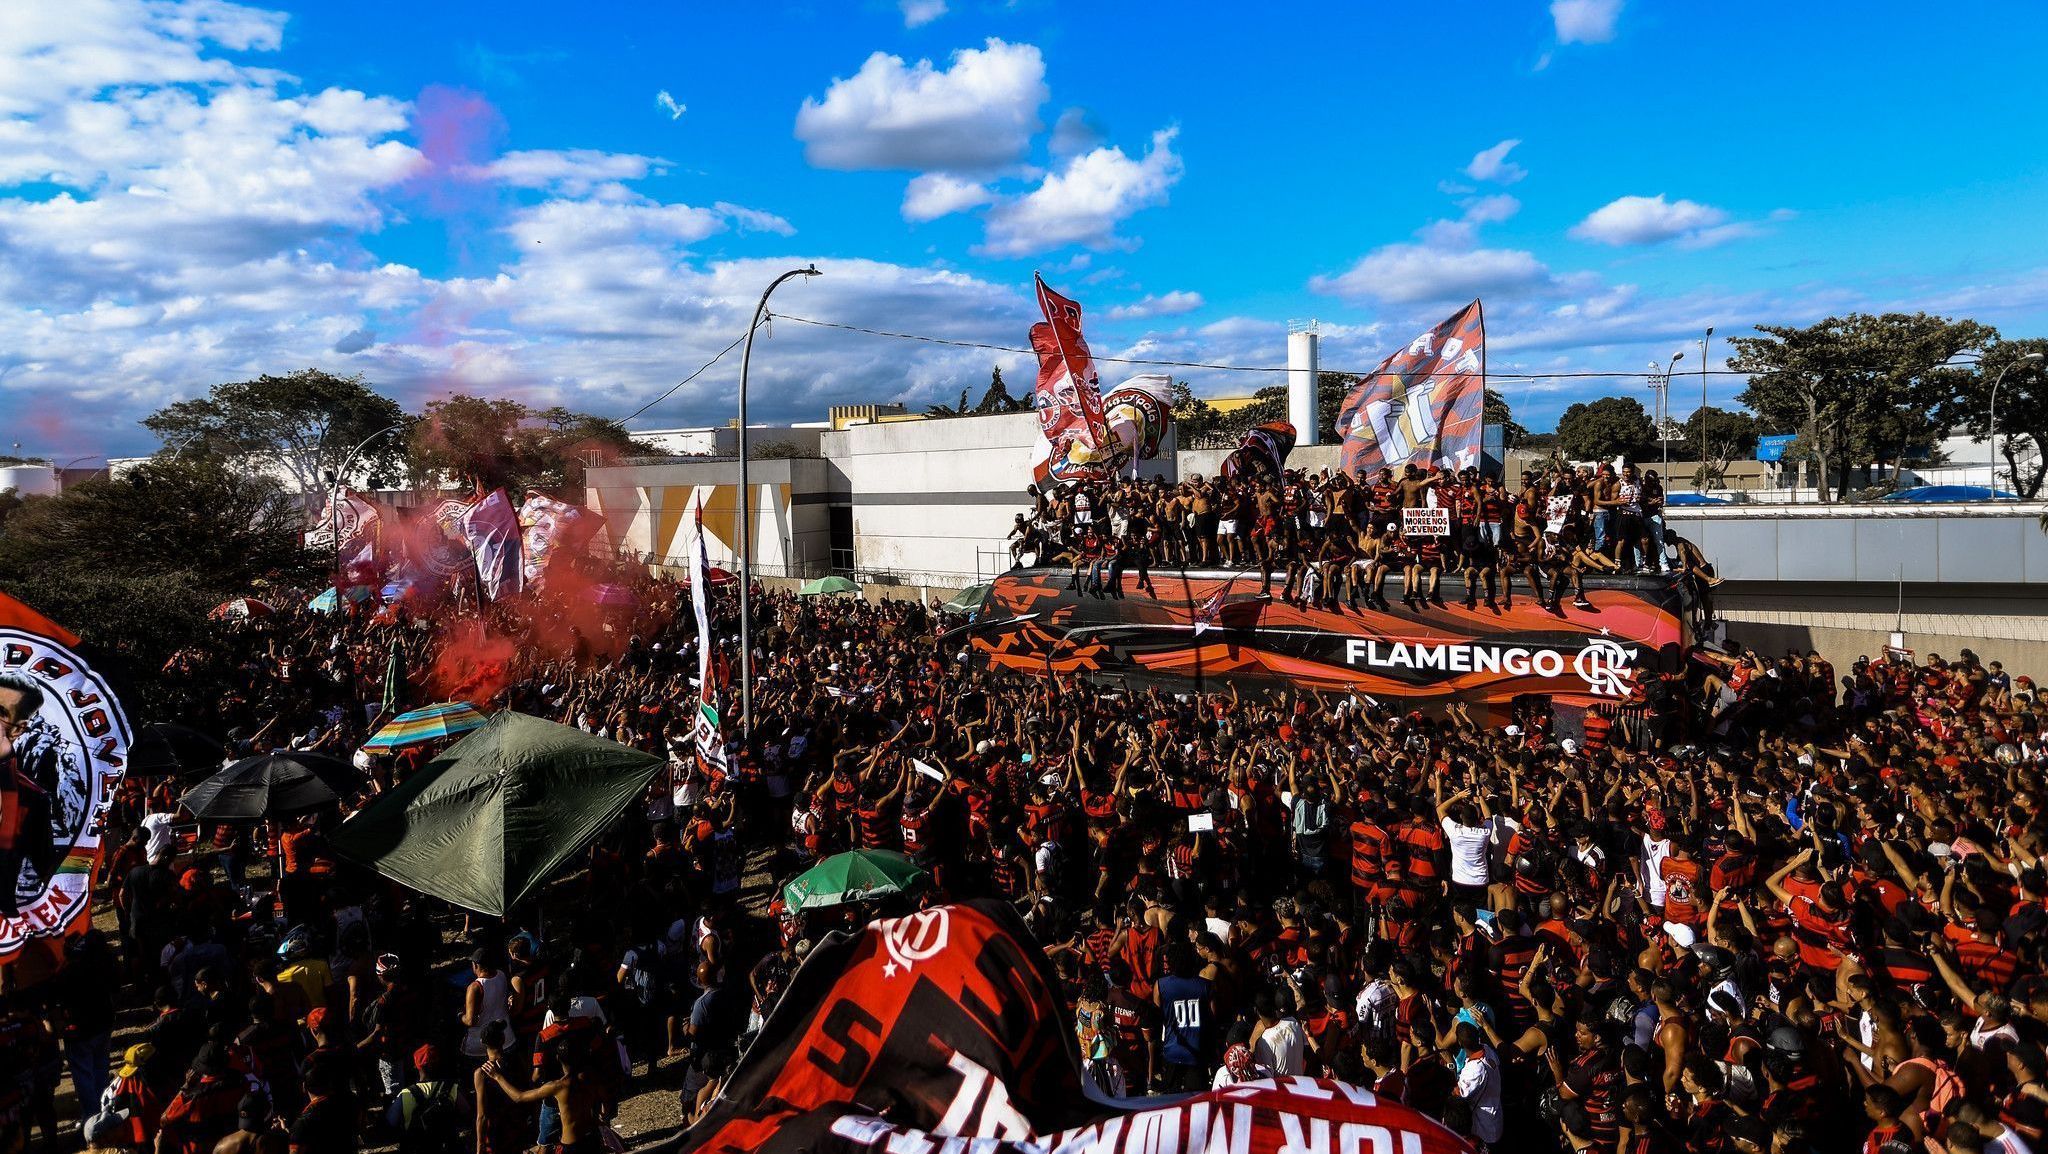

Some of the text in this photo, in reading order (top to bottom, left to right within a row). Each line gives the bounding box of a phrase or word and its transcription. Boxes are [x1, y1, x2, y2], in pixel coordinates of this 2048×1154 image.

[1405, 517, 1448, 525] MORRE NOS
[1407, 525, 1447, 535] DEVENDO!
[1346, 639, 1564, 677] FLAMENGO
